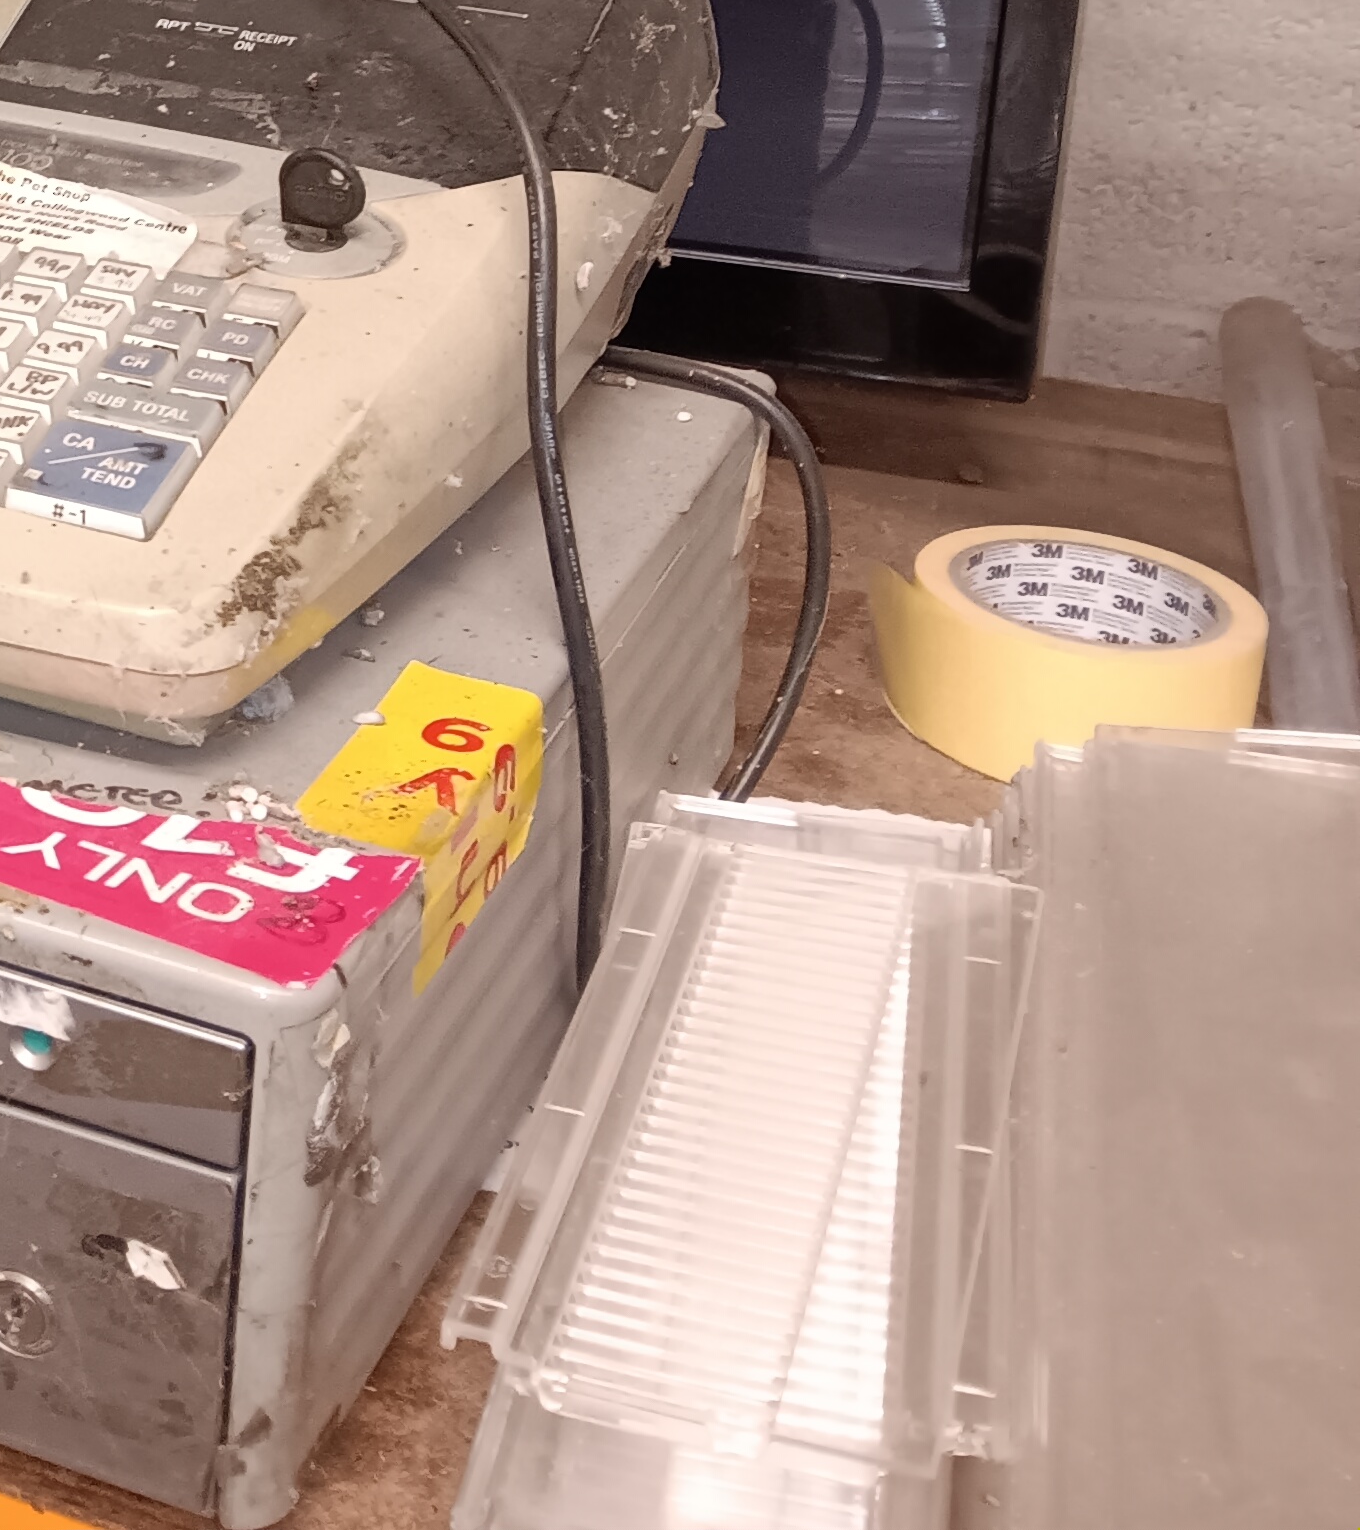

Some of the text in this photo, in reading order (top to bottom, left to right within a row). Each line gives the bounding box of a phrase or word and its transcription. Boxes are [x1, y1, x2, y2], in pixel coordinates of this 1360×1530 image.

[156, 18, 191, 31] RPT
[233, 39, 255, 52] ON
[238, 28, 298, 47] RECEIPT
[133, 218, 188, 235] Centre
[172, 283, 207, 297] VAT
[148, 317, 177, 330] RC
[222, 332, 249, 345] PD
[120, 355, 151, 369] CH
[186, 369, 230, 384] CHK
[83, 391, 189, 422] SUB TOTAL
[62, 433, 96, 451] CA
[98, 457, 149, 475] AMT
[81, 468, 136, 489] TEND
[1031, 543, 1064, 560] 3M
[985, 564, 1012, 581] 3M
[1071, 566, 1105, 585] 3M
[1127, 558, 1159, 581] 3M
[1017, 582, 1049, 597] 3M
[1055, 603, 1089, 622] 3M
[1112, 595, 1144, 617] 3M
[1164, 592, 1190, 617] 3M
[0, 831, 254, 922] ONLY
